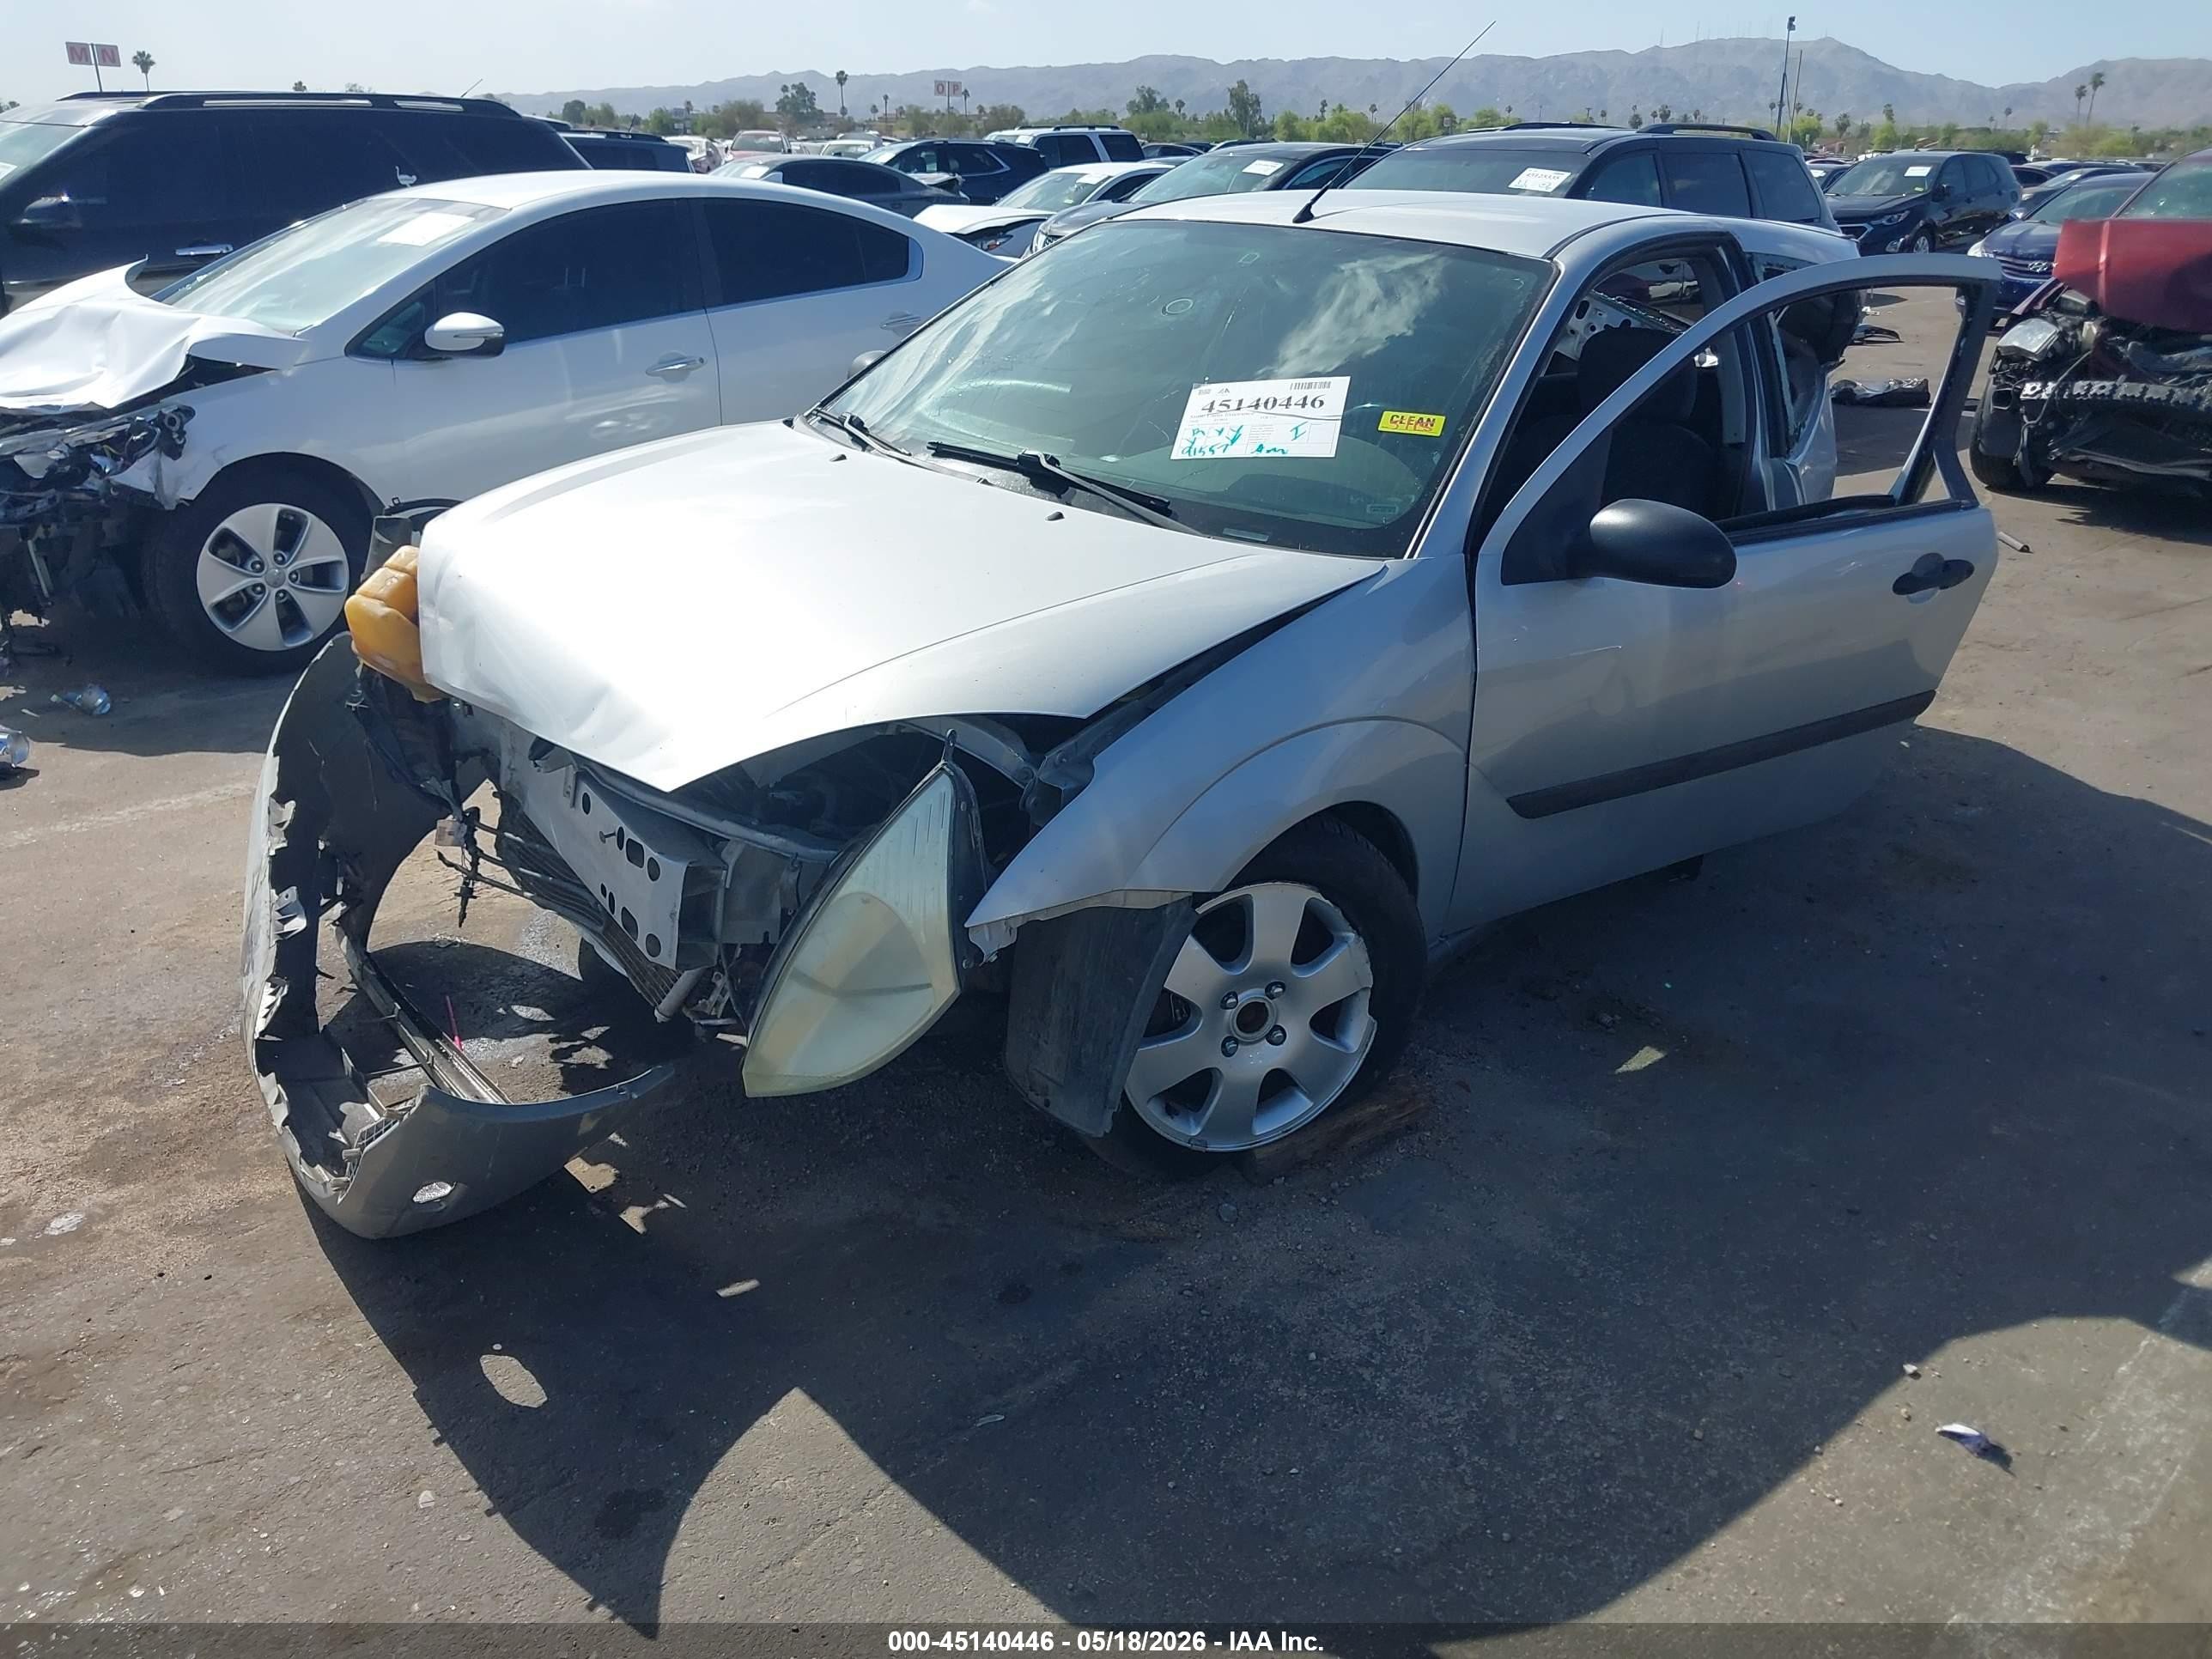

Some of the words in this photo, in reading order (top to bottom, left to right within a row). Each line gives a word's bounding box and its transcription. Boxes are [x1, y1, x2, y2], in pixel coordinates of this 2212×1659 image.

[69, 46, 88, 63] M
[100, 47, 116, 64] N
[953, 83, 959, 94] P
[1201, 394, 1327, 413] 45140446
[1389, 414, 1436, 428] CLEAN
